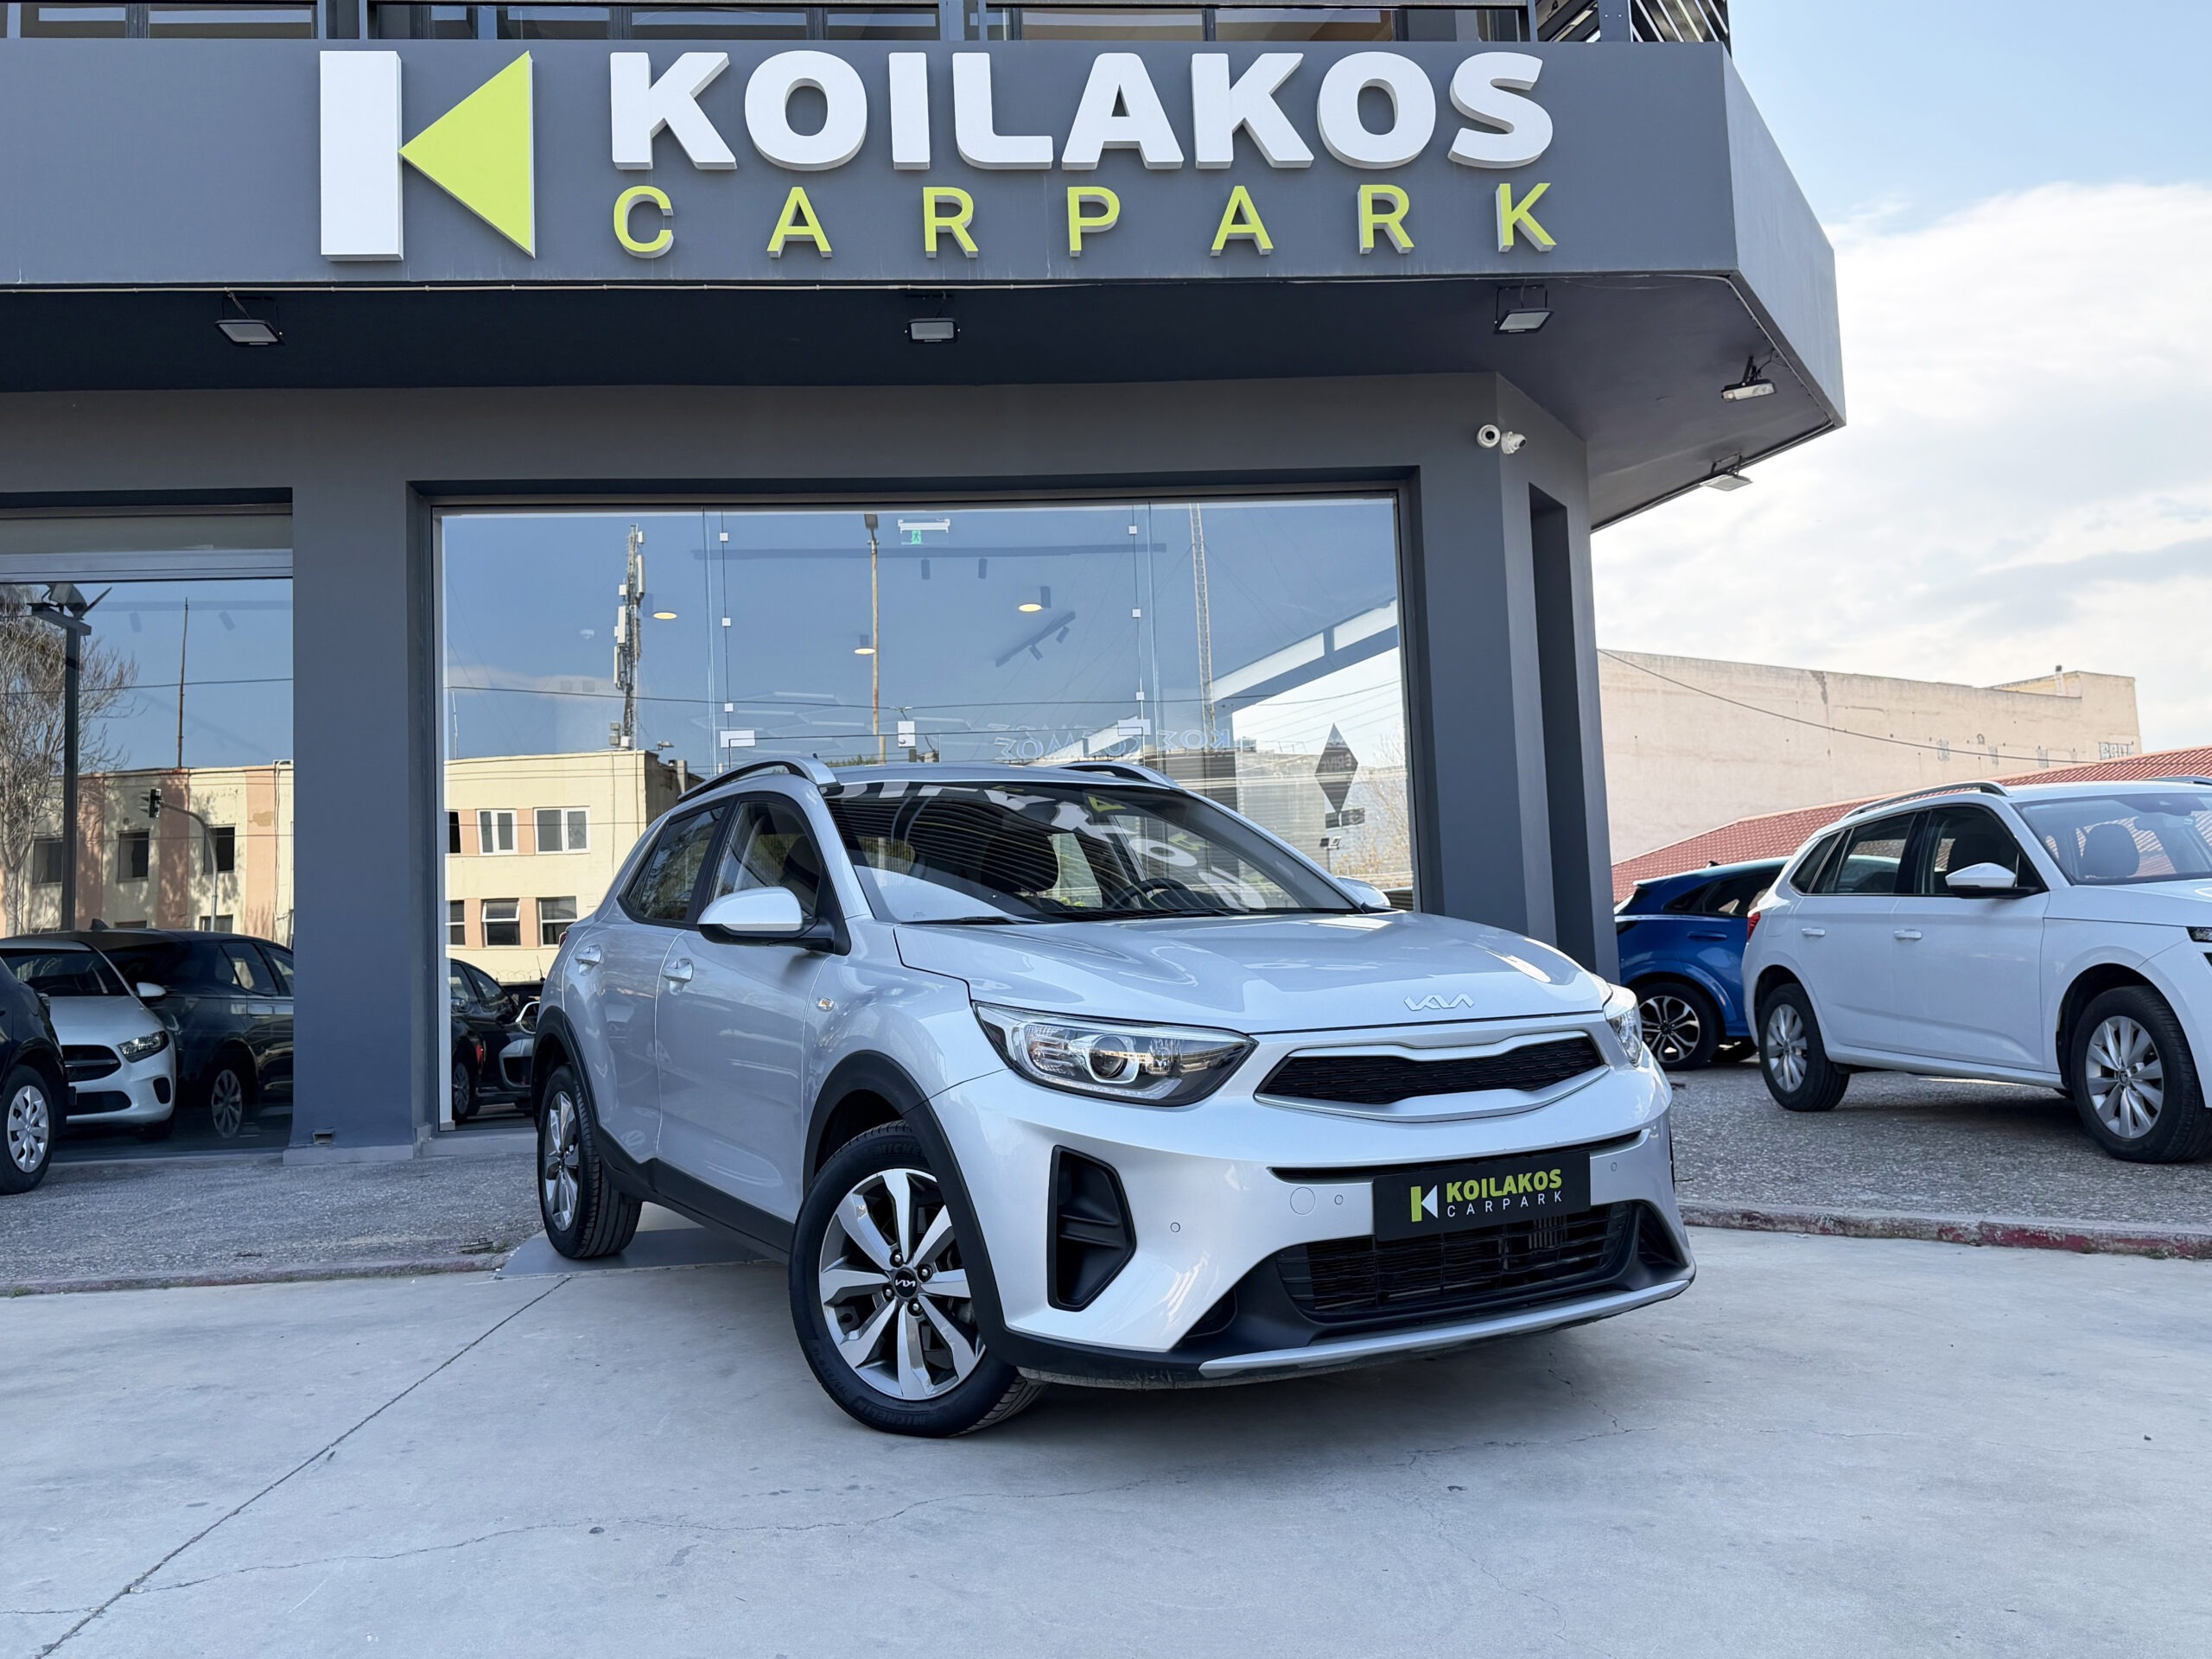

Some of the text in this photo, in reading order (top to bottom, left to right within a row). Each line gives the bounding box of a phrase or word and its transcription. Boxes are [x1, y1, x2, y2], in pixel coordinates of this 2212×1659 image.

[610, 50, 1554, 171] KOILAKOS
[613, 182, 1556, 259] CARPARK
[1446, 1168, 1563, 1203] KOILAKOS
[1446, 1191, 1562, 1217] CARPARK
